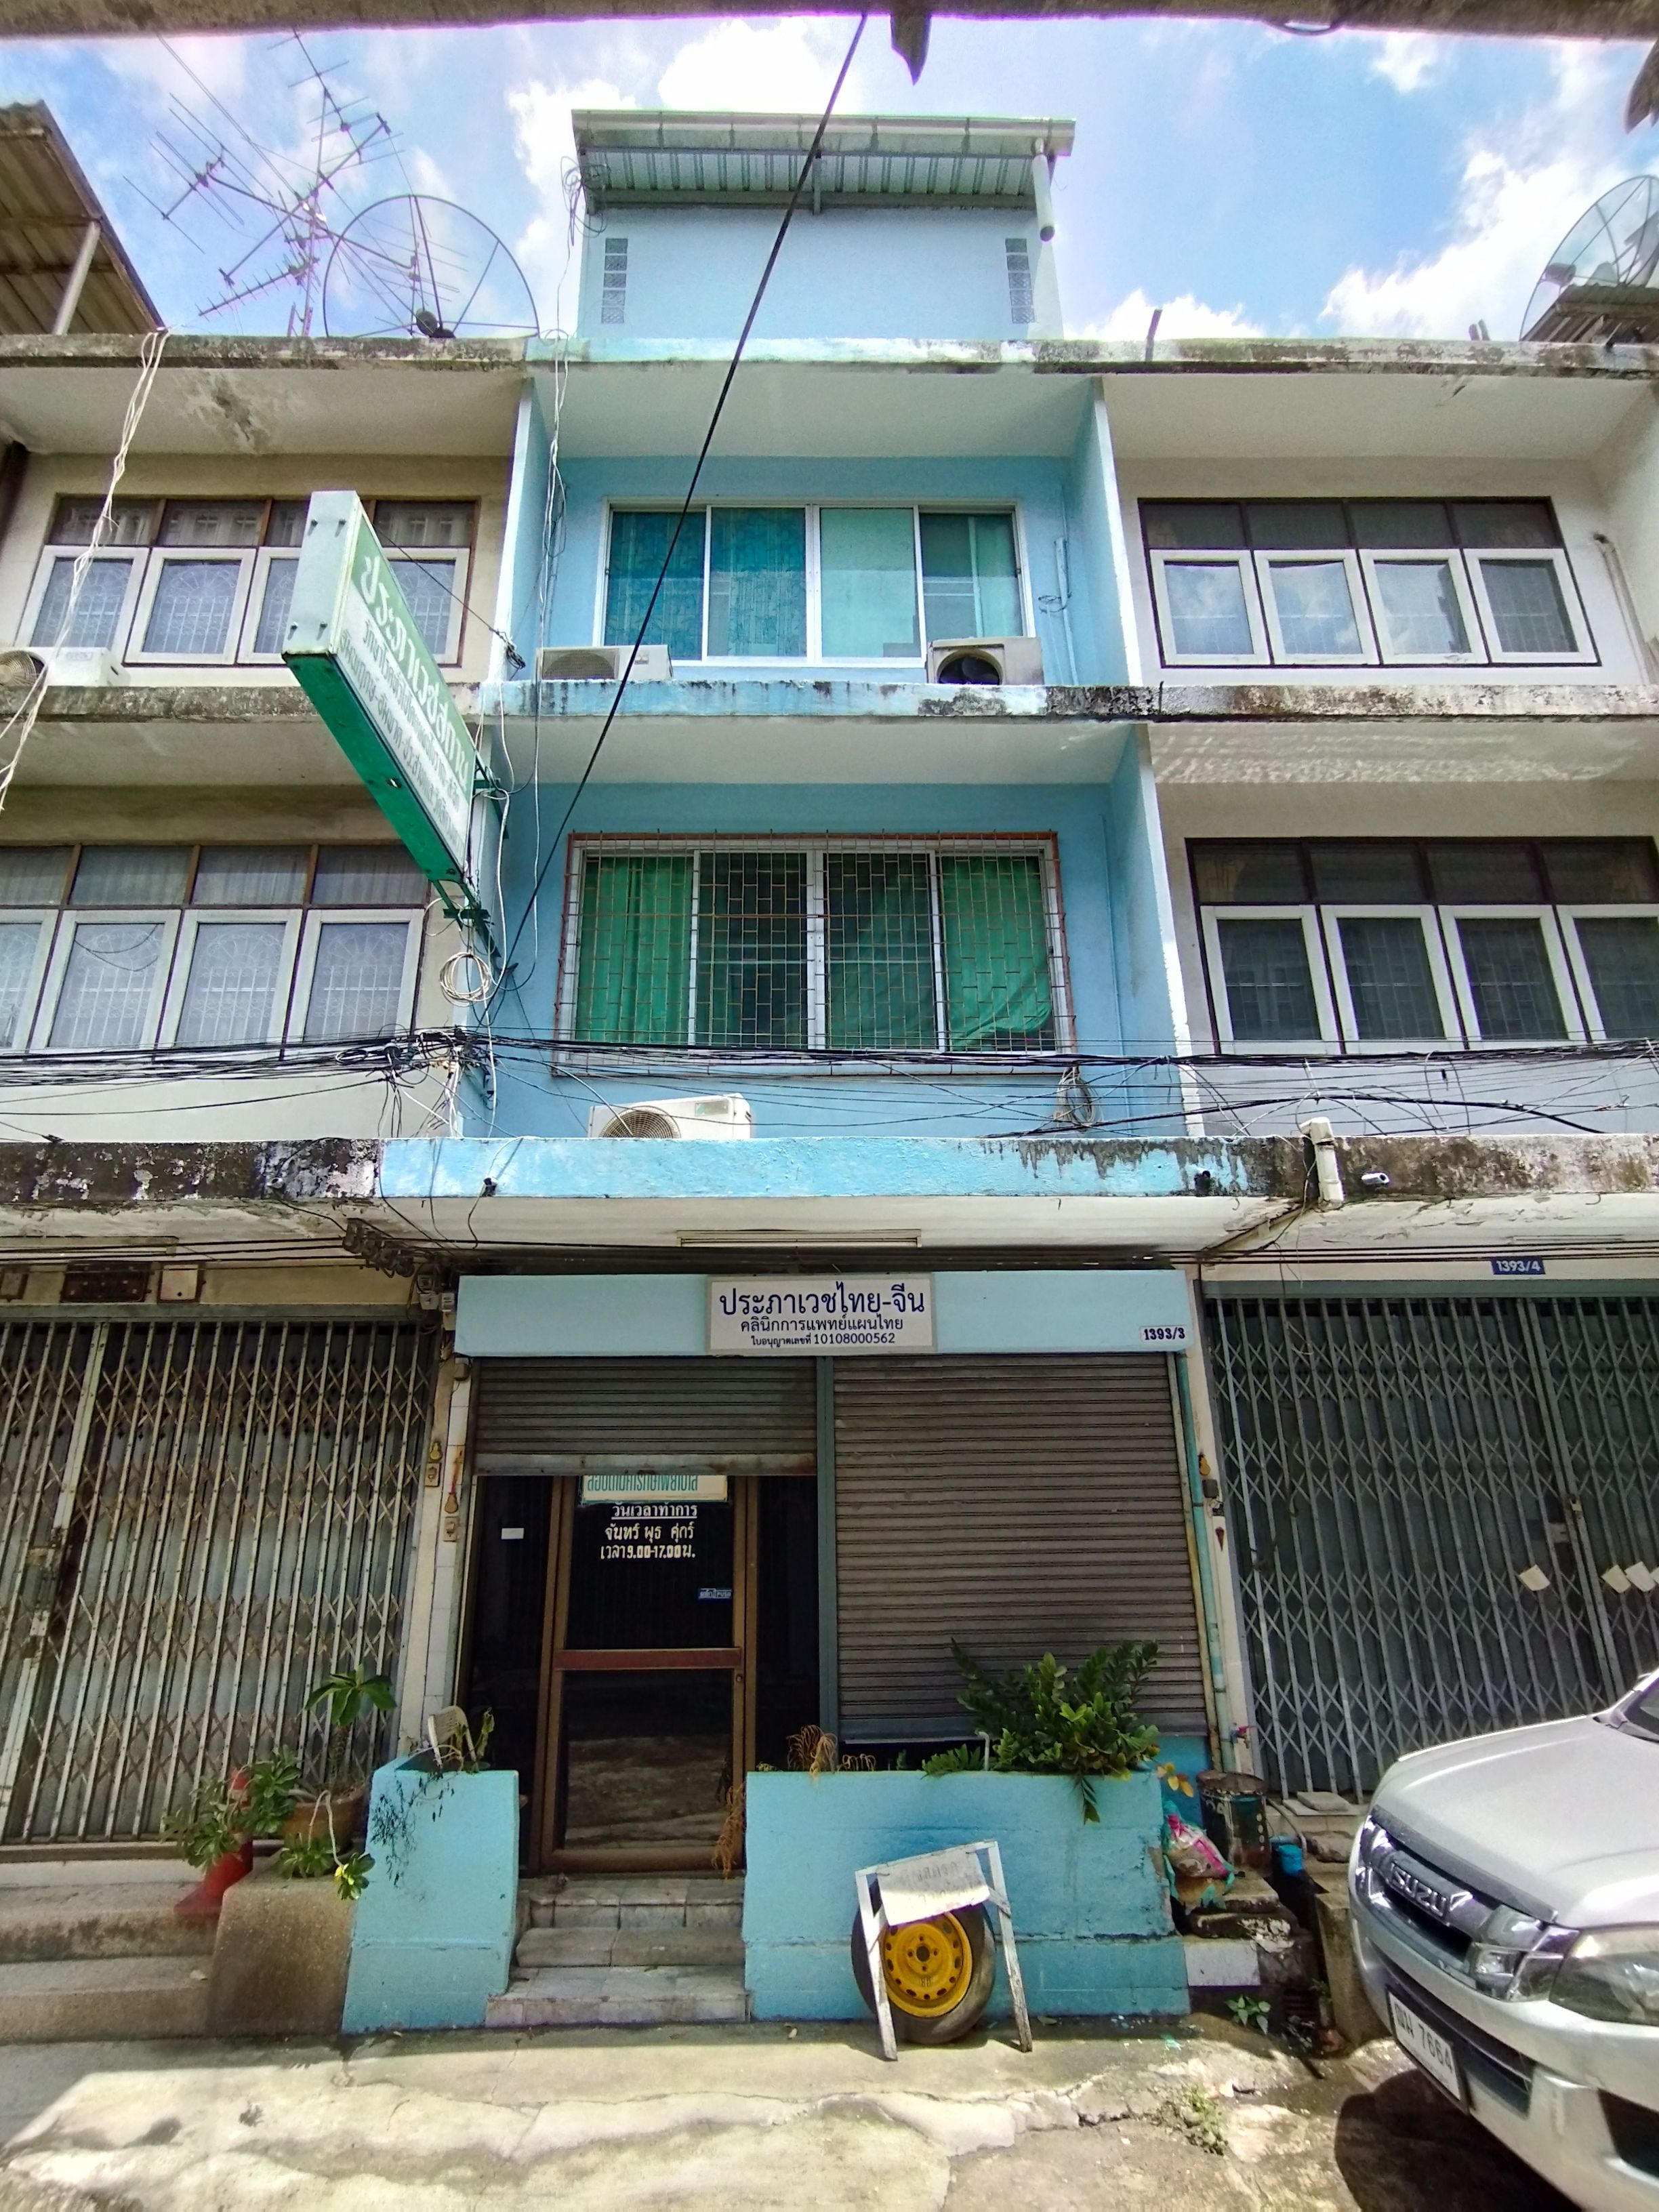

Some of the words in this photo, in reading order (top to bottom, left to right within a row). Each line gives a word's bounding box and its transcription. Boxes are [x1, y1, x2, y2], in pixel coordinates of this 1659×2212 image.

[361, 556, 468, 792] ประภาเวชสถาน
[1496, 1261, 1541, 1271] 1393/4
[720, 1281, 924, 1315] ประภาเวชไทย-จีน
[741, 1313, 903, 1332] คลินิกการแพทย์แผนไทย
[751, 1332, 811, 1348] ใบอนุญาตเลขที่
[814, 1332, 895, 1345] 10108000562
[1144, 1327, 1185, 1340] 1393/3
[612, 1501, 697, 1517] วันเวลาทำการ
[605, 1523, 640, 1540] จันทร์
[644, 1525, 661, 1543] พุธ
[1389, 1862, 1448, 1917] ISUZU
